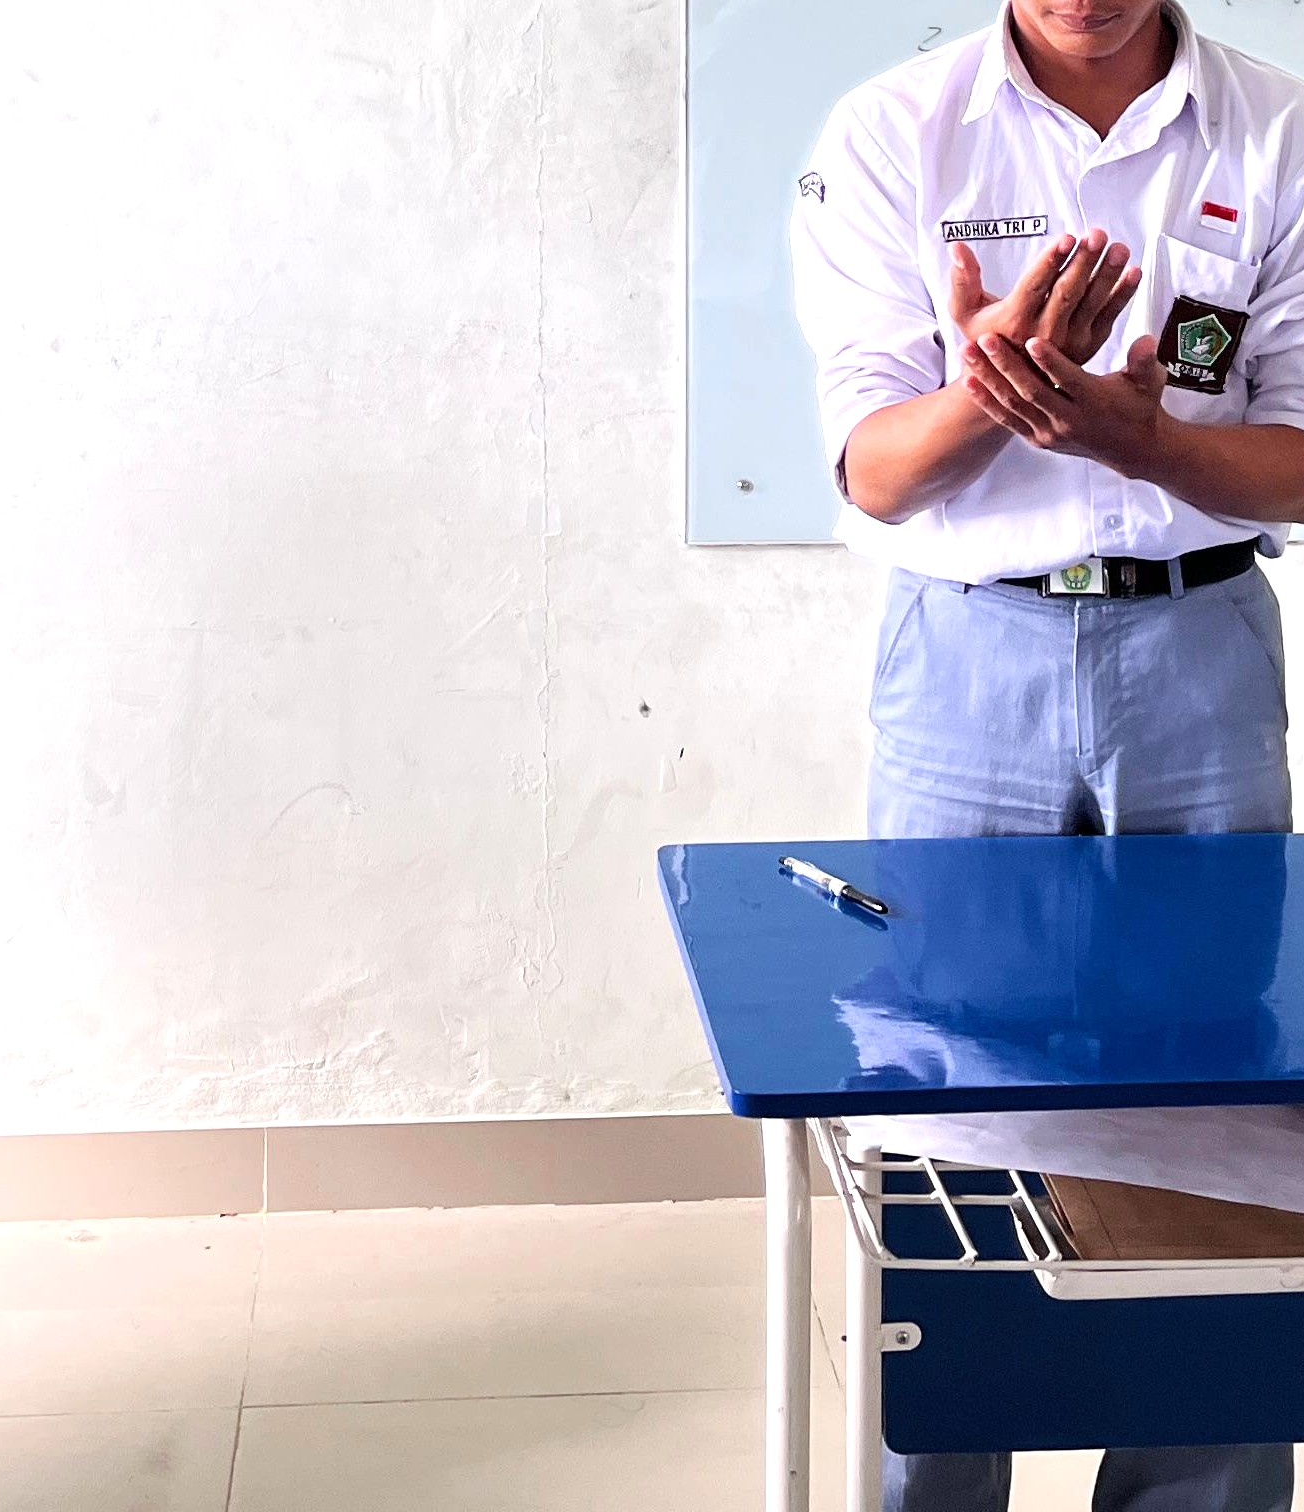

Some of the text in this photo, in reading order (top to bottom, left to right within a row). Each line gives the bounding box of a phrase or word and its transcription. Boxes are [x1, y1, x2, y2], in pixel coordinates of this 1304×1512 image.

[946, 219, 1041, 239] ANDHIKA TRI P
